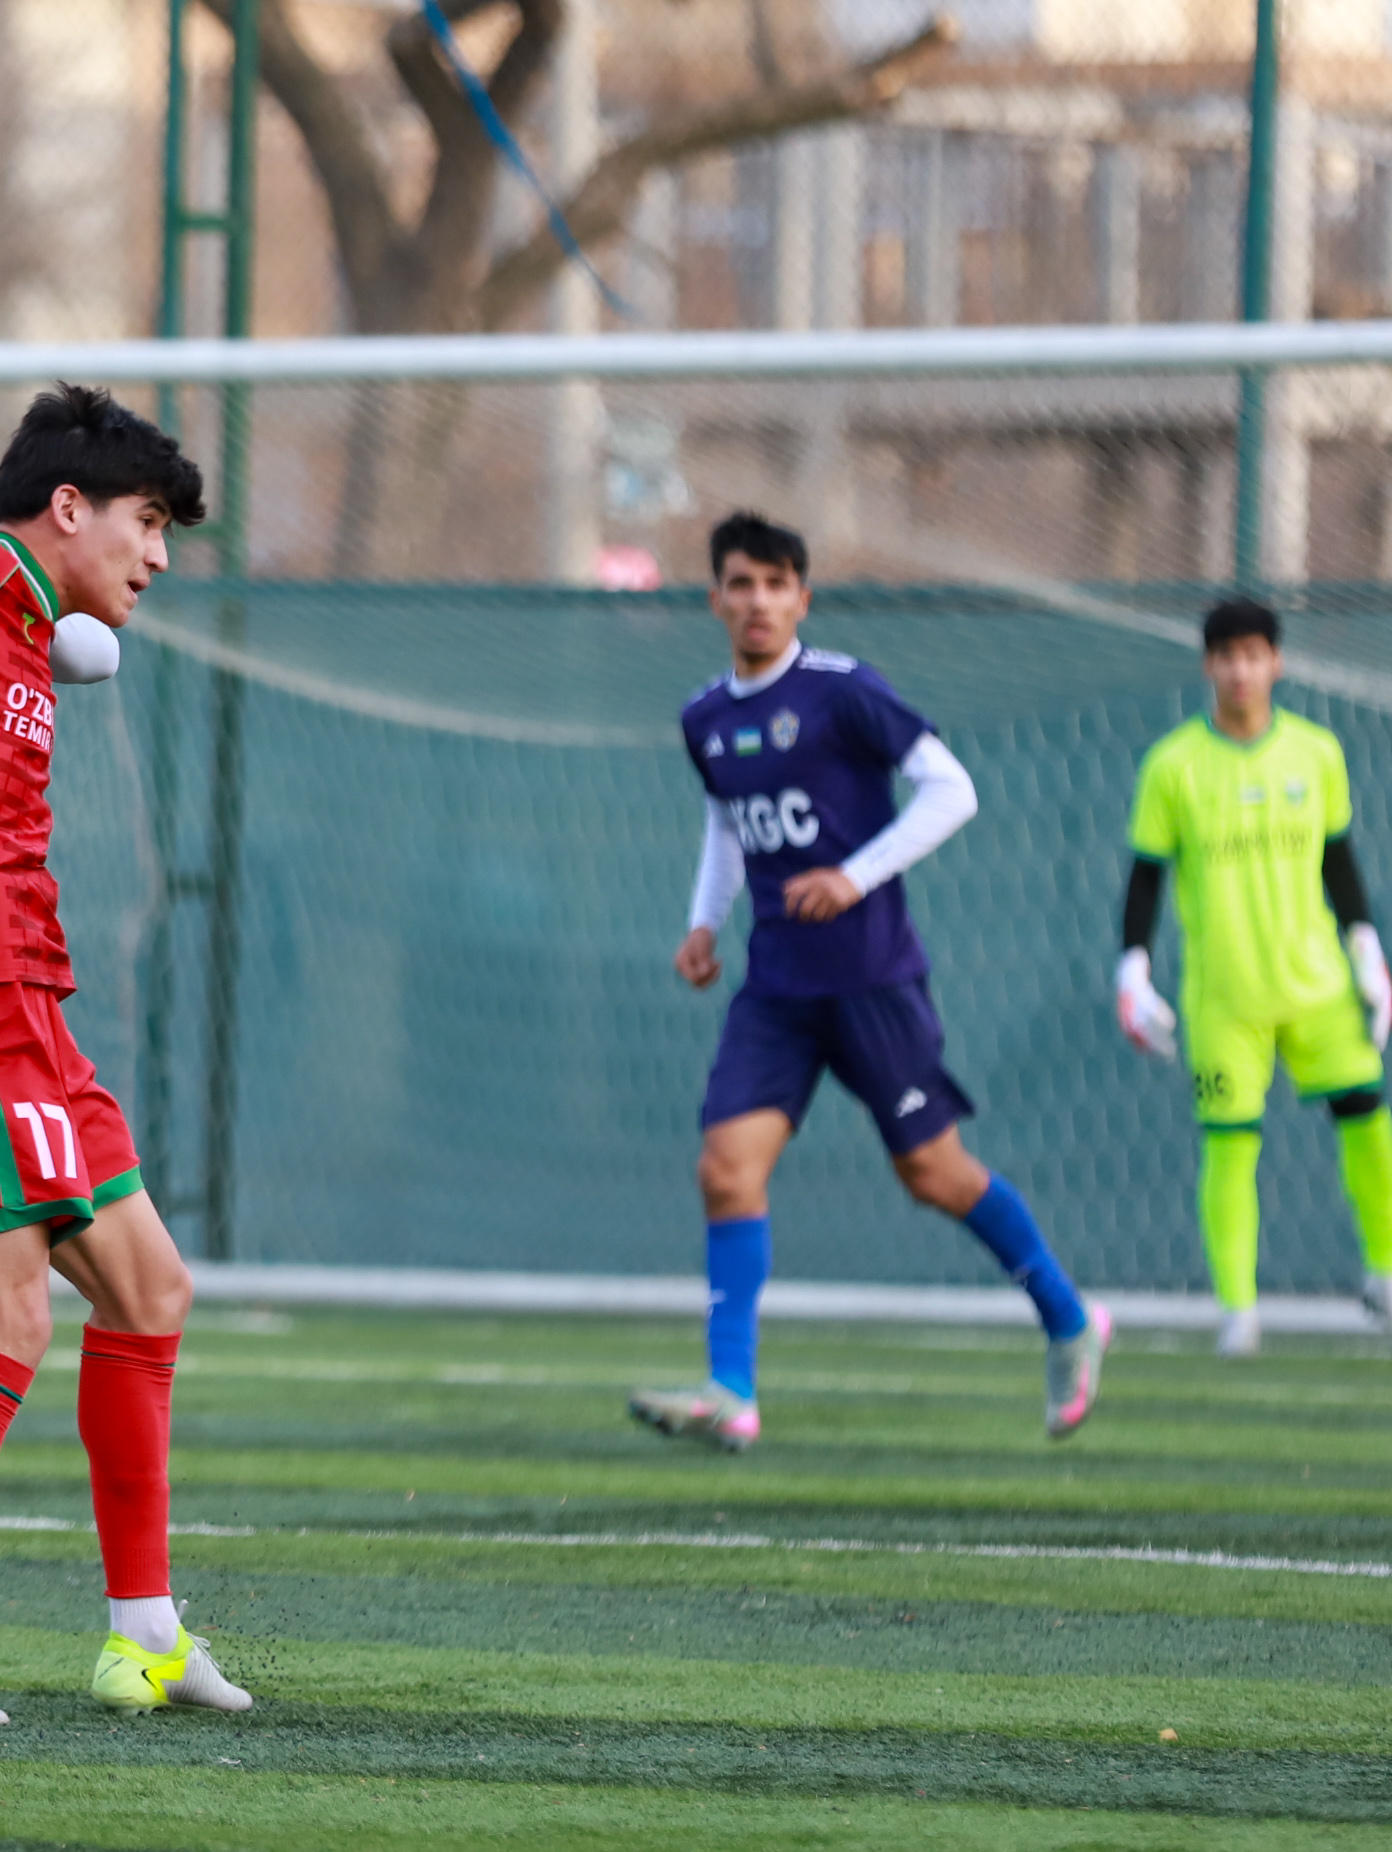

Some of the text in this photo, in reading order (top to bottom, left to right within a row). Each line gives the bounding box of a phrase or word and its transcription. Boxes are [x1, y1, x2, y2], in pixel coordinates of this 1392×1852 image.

[3, 709, 54, 751] TEMIR
[7, 682, 54, 726] O'ZB
[730, 787, 820, 854] KGC
[13, 1101, 78, 1180] 17
